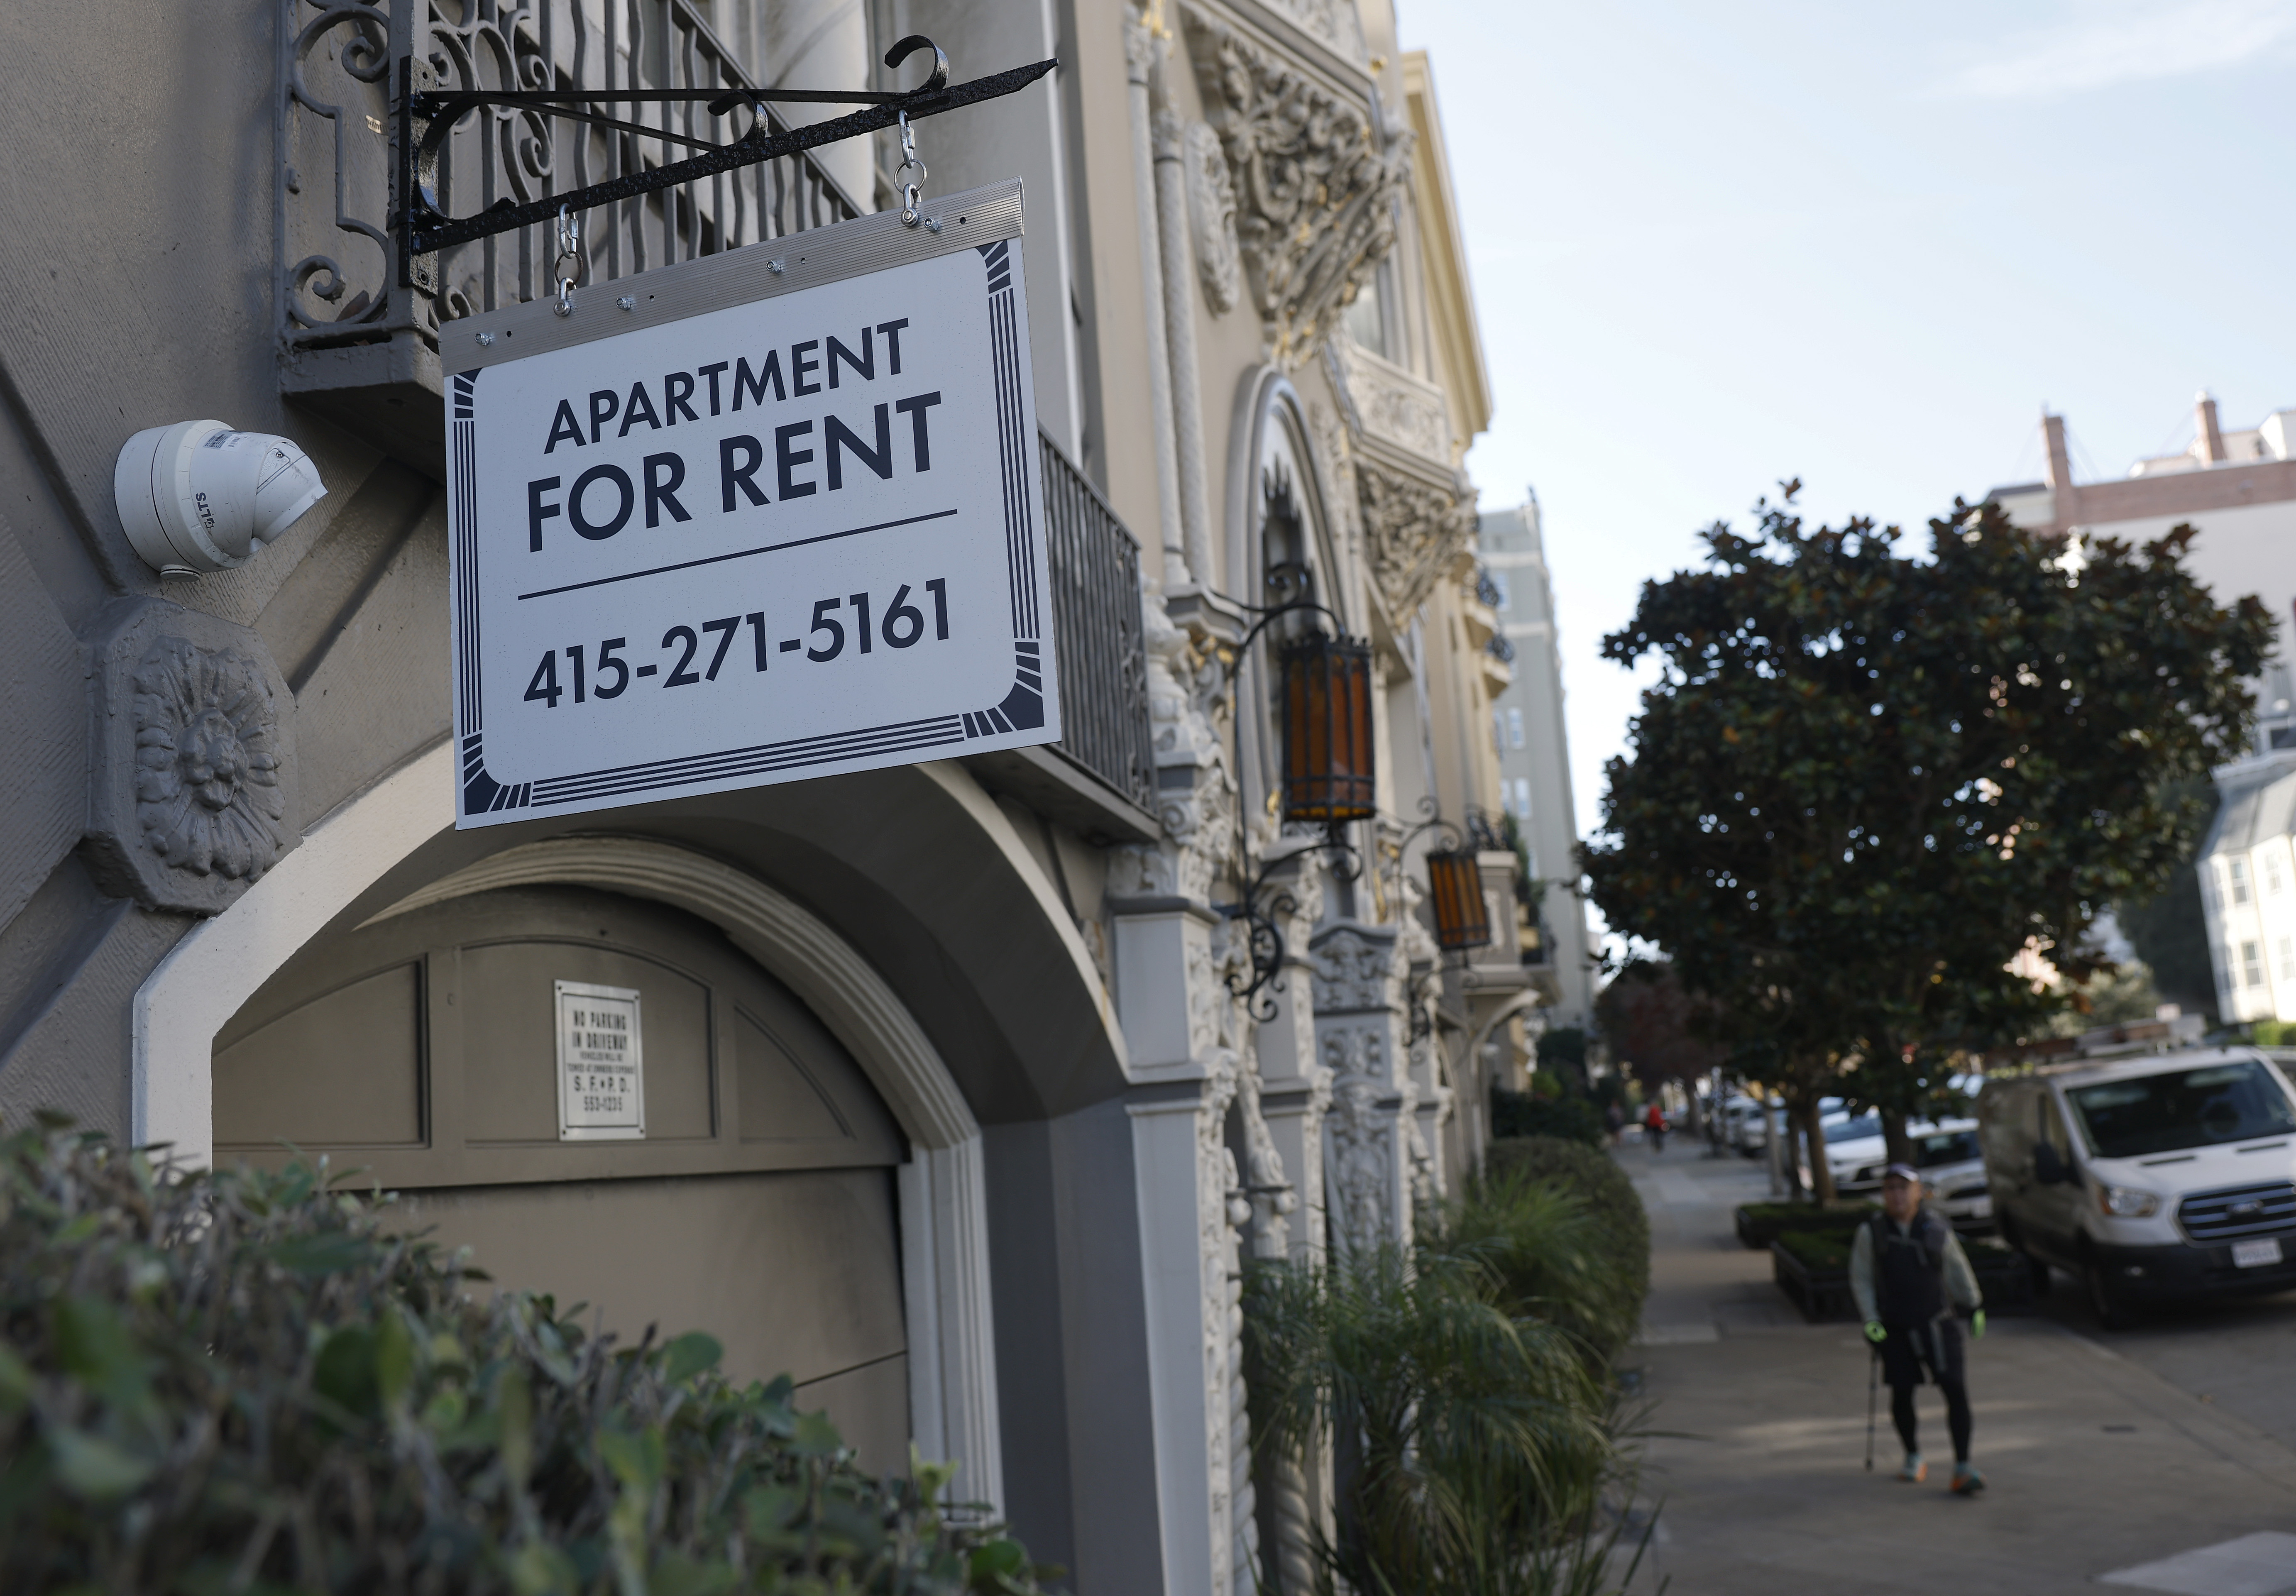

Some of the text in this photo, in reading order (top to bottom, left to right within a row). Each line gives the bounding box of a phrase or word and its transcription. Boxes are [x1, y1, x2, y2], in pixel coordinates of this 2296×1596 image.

[544, 318, 908, 454] APARTMENT
[196, 492, 212, 518] LTS
[528, 391, 941, 552] FOR RENT
[524, 578, 949, 708] 415-271-5161
[572, 1031, 628, 1050] IN DRIVEWAY
[573, 1009, 626, 1030] NO PARKING
